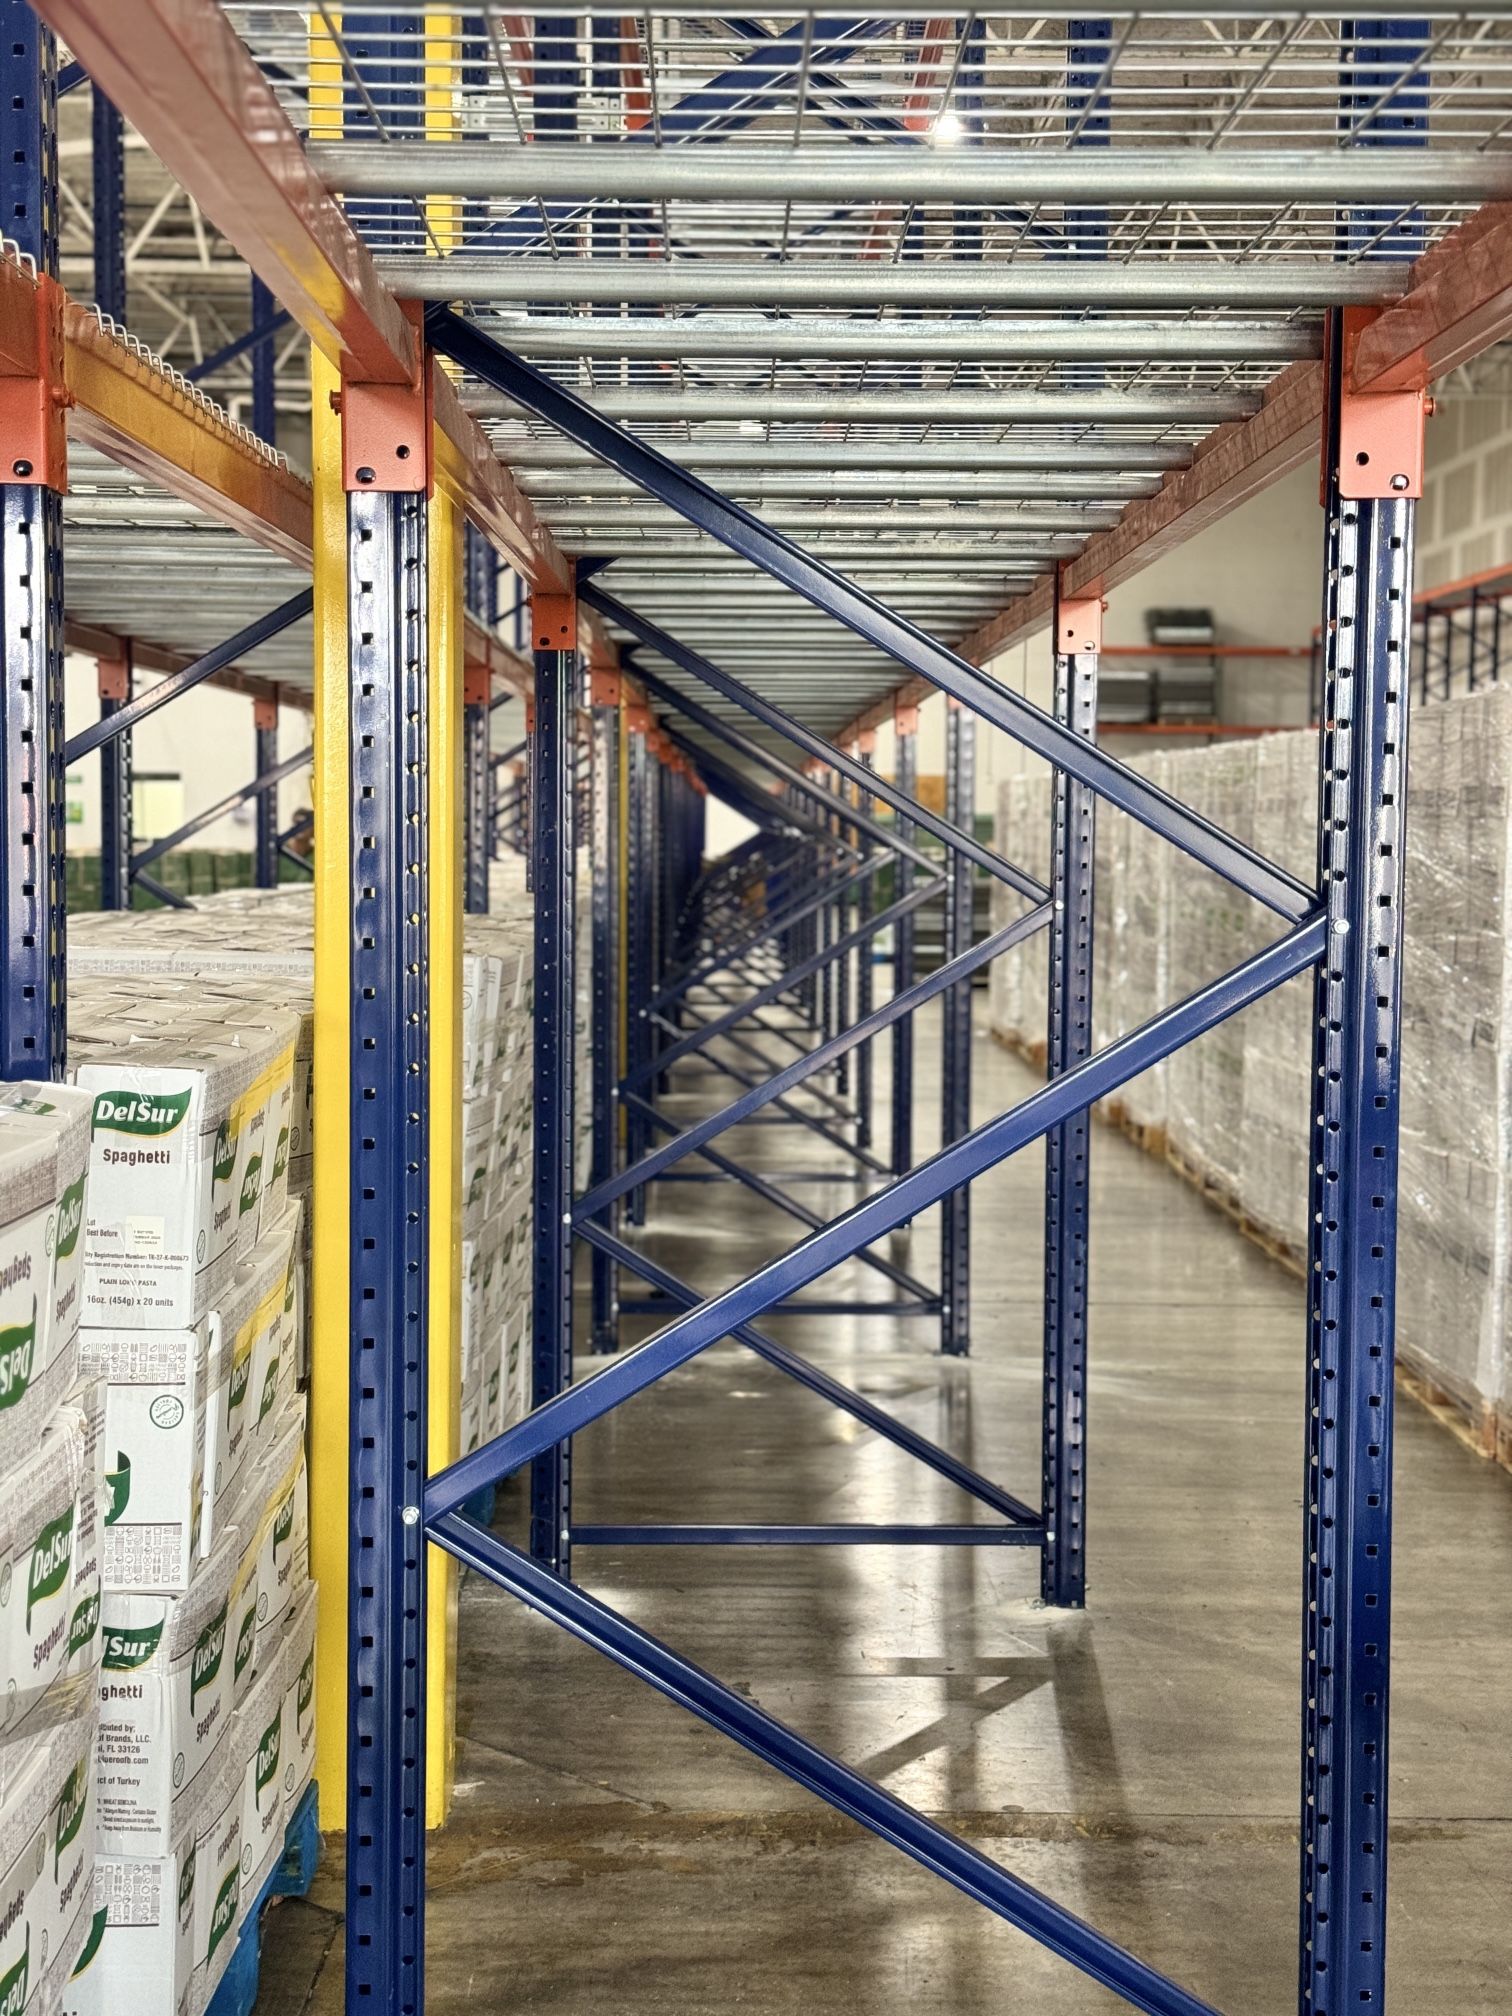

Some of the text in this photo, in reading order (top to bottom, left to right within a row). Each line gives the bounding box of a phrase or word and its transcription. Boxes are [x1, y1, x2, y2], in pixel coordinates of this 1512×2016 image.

[96, 1100, 179, 1124] DelSur
[103, 1149, 170, 1166] Spaghetti
[100, 1229, 118, 1237] Before
[87, 1295, 106, 1304] 16oz.
[109, 1296, 135, 1306] (454g)
[143, 1298, 153, 1306] 20
[155, 1299, 174, 1307] units
[33, 1530, 73, 1590] DelSur
[34, 1612, 66, 1671] Spaghetti
[98, 1685, 143, 1701] ghetti
[106, 1735, 133, 1743] Brands,
[135, 1735, 151, 1743] LLC.
[108, 1776, 115, 1785] of
[117, 1777, 140, 1786] Turkey
